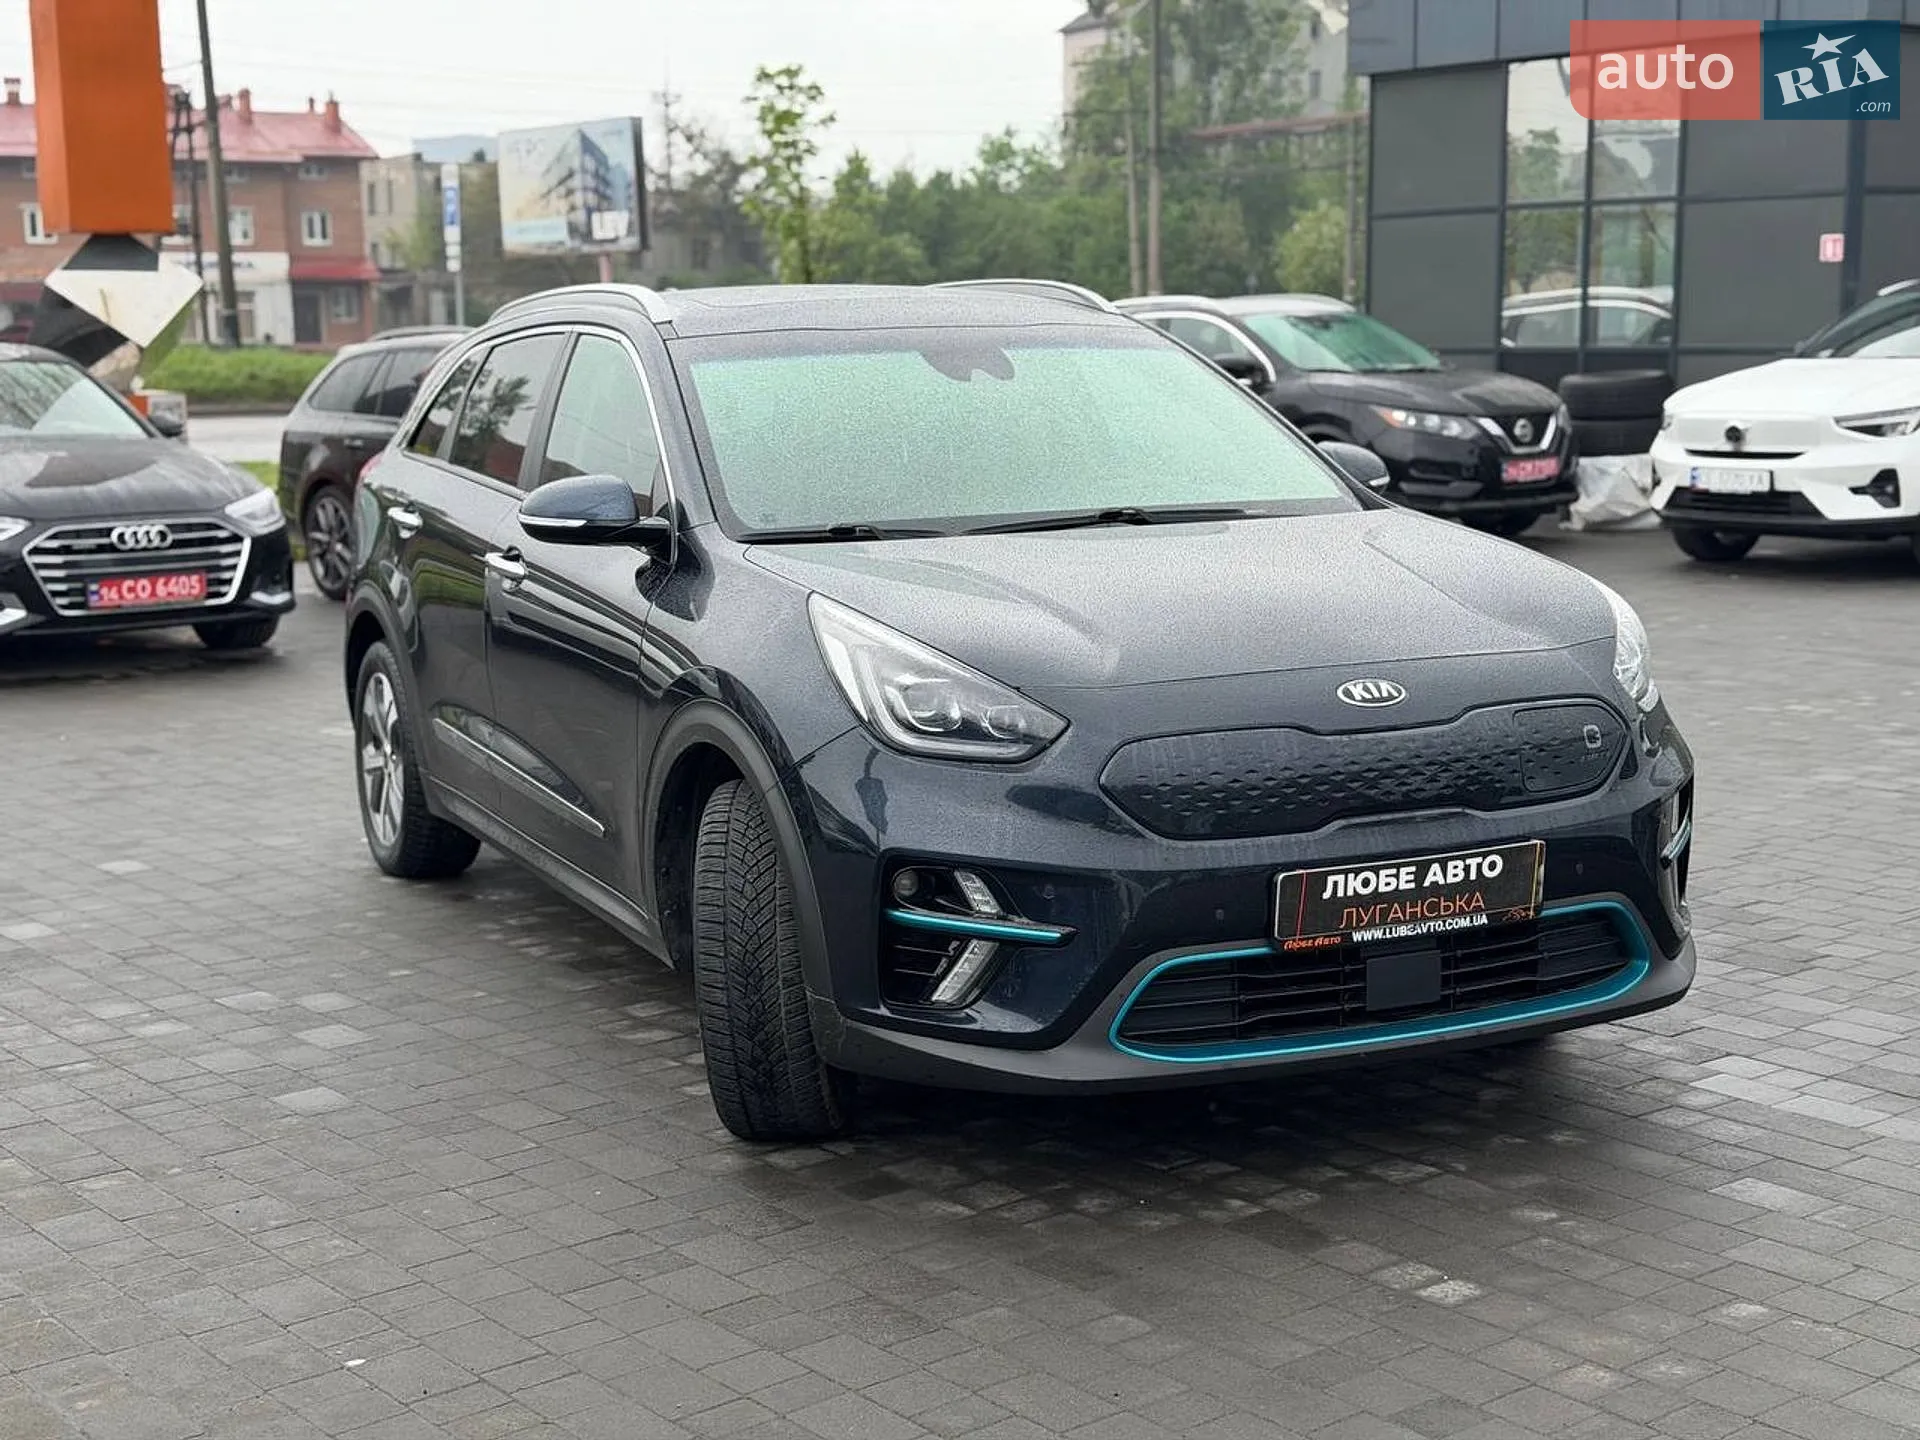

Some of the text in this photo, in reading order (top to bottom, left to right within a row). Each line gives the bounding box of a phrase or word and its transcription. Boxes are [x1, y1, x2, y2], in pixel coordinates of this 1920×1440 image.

[121, 579, 152, 599] CO
[155, 574, 201, 598] 6405
[1347, 681, 1399, 701] KIA
[1322, 854, 1504, 900] ЛЮБЕ АВТО
[1339, 891, 1486, 930] ЛУГАНСЬКА
